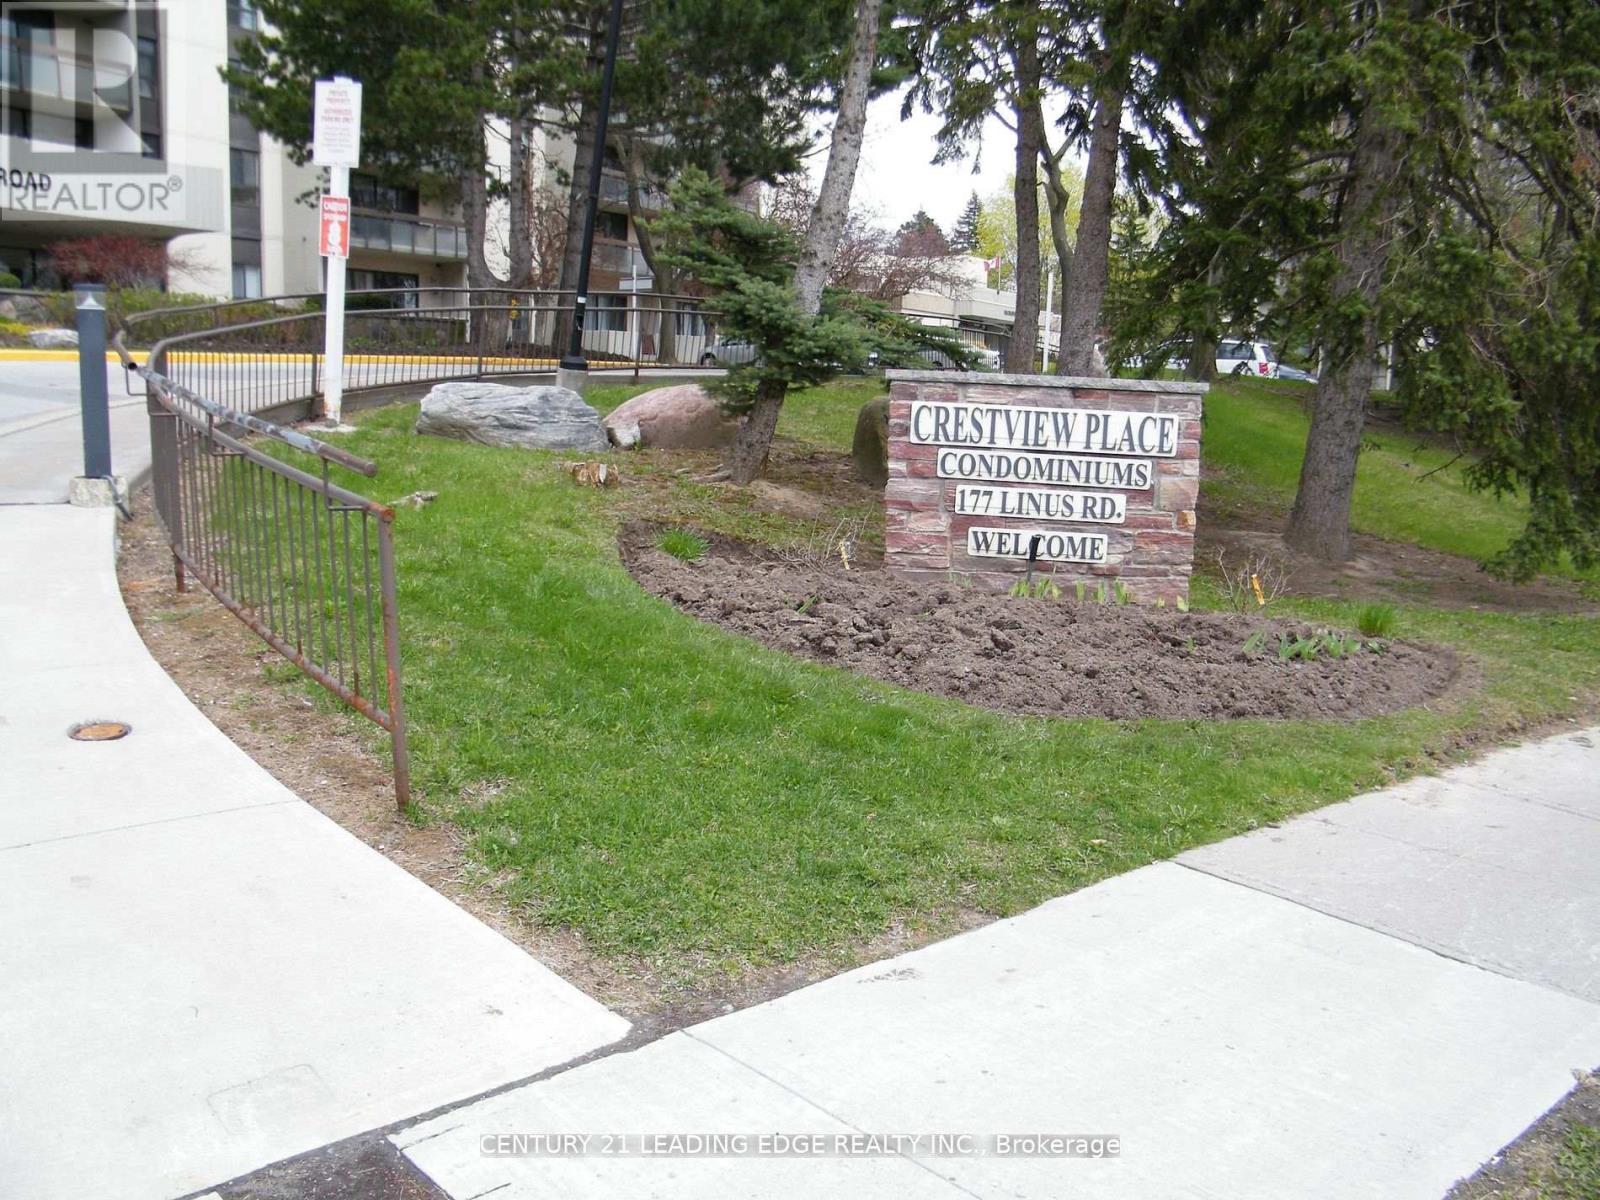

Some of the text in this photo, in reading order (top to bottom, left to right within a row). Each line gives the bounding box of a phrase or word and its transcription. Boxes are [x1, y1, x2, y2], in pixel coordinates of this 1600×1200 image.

[914, 405, 1174, 454] CRESTVIEW PLACE
[940, 452, 1148, 487] CONDOMINIUMS
[958, 489, 1122, 520] 177 LINUS RD.
[972, 531, 1104, 560] WELCOME
